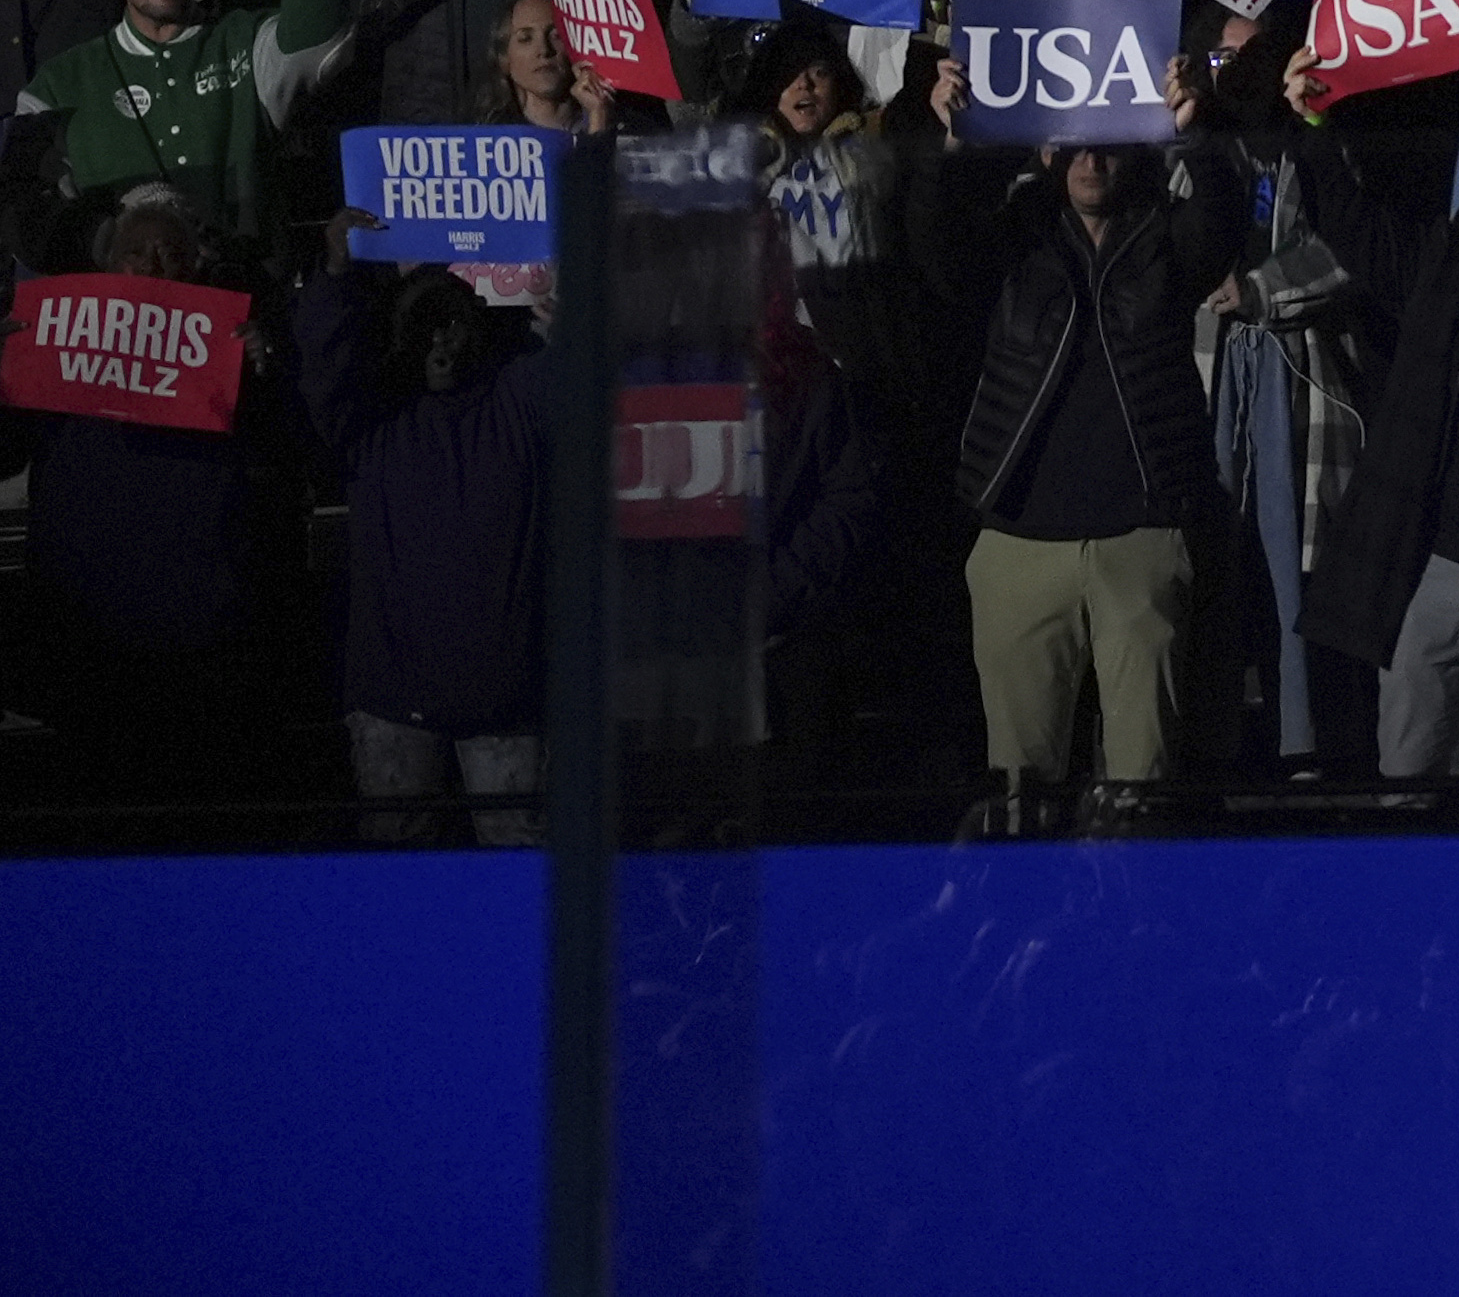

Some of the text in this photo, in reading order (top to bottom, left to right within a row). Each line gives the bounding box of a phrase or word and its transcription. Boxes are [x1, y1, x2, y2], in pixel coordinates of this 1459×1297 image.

[963, 26, 1165, 109] USA
[379, 137, 544, 177] VOTE FOR
[384, 178, 546, 221] FREEDOM
[36, 297, 212, 367] HARRIS
[60, 352, 179, 397] WALZ
